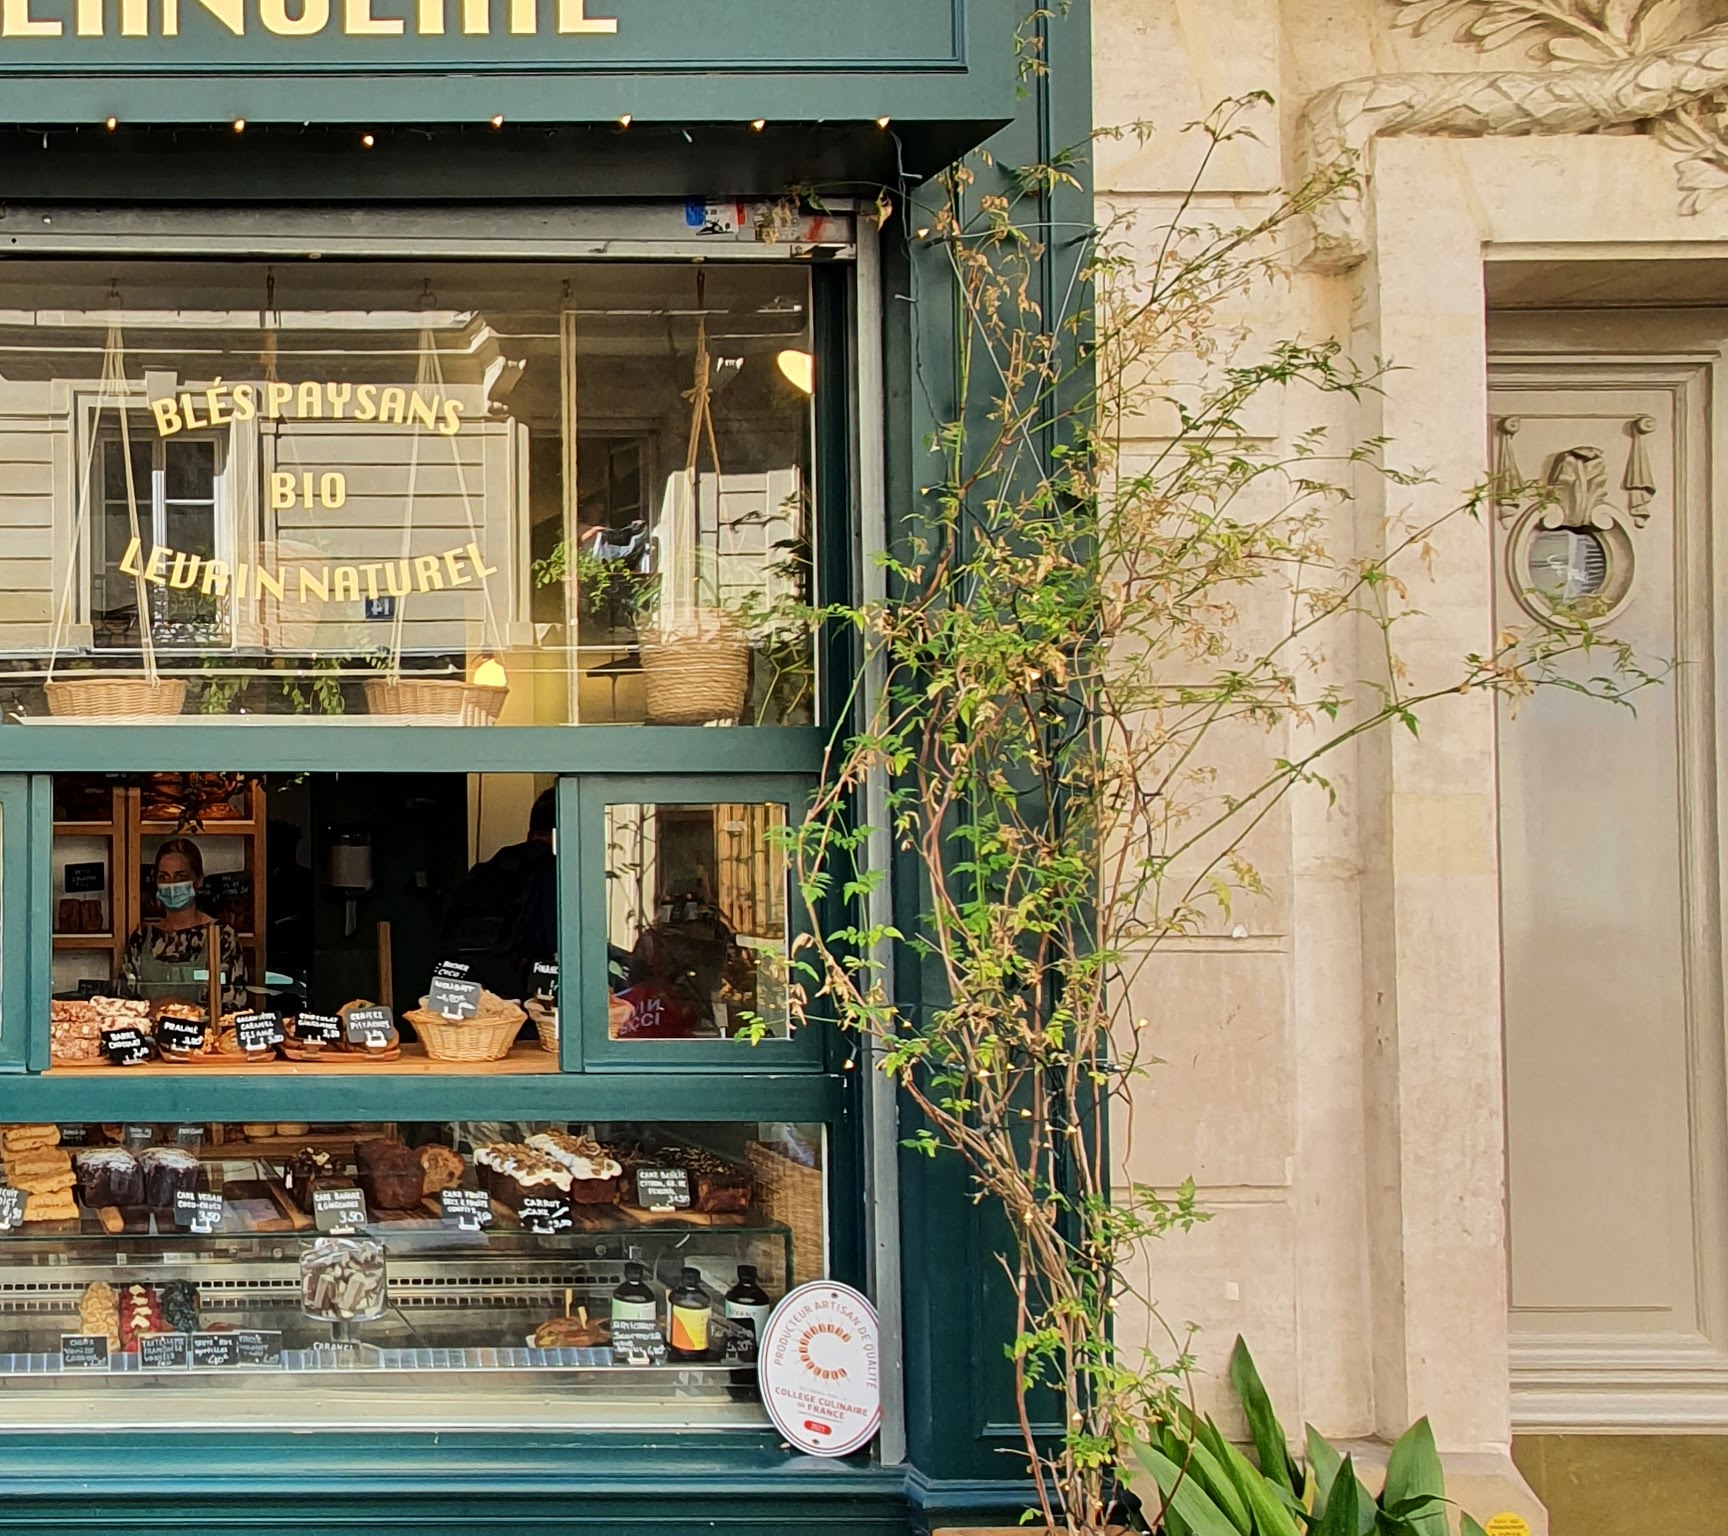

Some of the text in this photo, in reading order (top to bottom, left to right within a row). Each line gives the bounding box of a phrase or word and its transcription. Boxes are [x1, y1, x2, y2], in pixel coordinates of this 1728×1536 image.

[152, 376, 465, 437] BLÉS PAYSANS
[272, 472, 347, 509] BIO
[119, 537, 498, 603] LEVAIN NATUREL
[524, 1198, 560, 1208] CARROT
[774, 1305, 812, 1366] PRODUCTEUR
[814, 1300, 862, 1329] ARTISAN
[857, 1325, 871, 1342] DE
[807, 1404, 846, 1420] FRANCE
[819, 1397, 869, 1417] CULINAIRE
